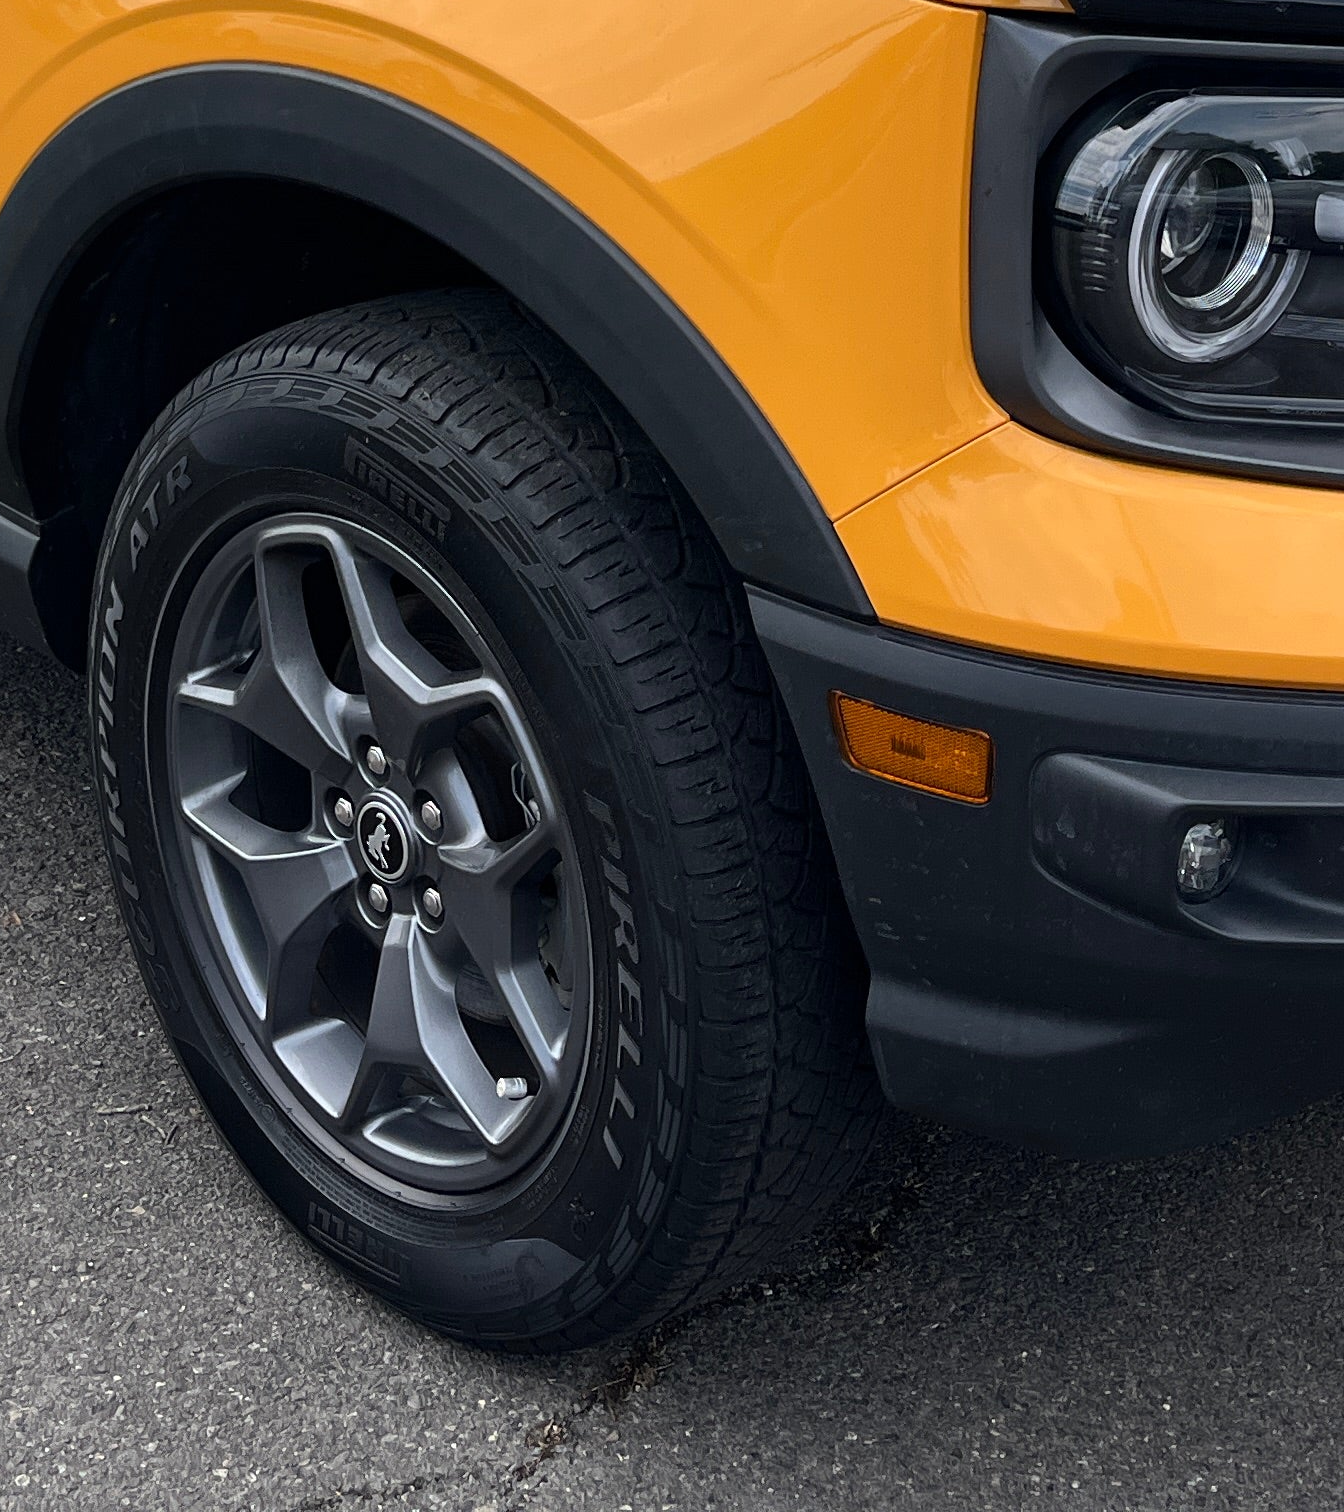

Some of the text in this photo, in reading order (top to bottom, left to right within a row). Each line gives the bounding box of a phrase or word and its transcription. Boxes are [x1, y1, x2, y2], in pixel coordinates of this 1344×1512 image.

[343, 434, 452, 544] PIRELLI
[97, 454, 193, 1013] SCORPION ATR
[582, 789, 644, 1171] PIRELLI
